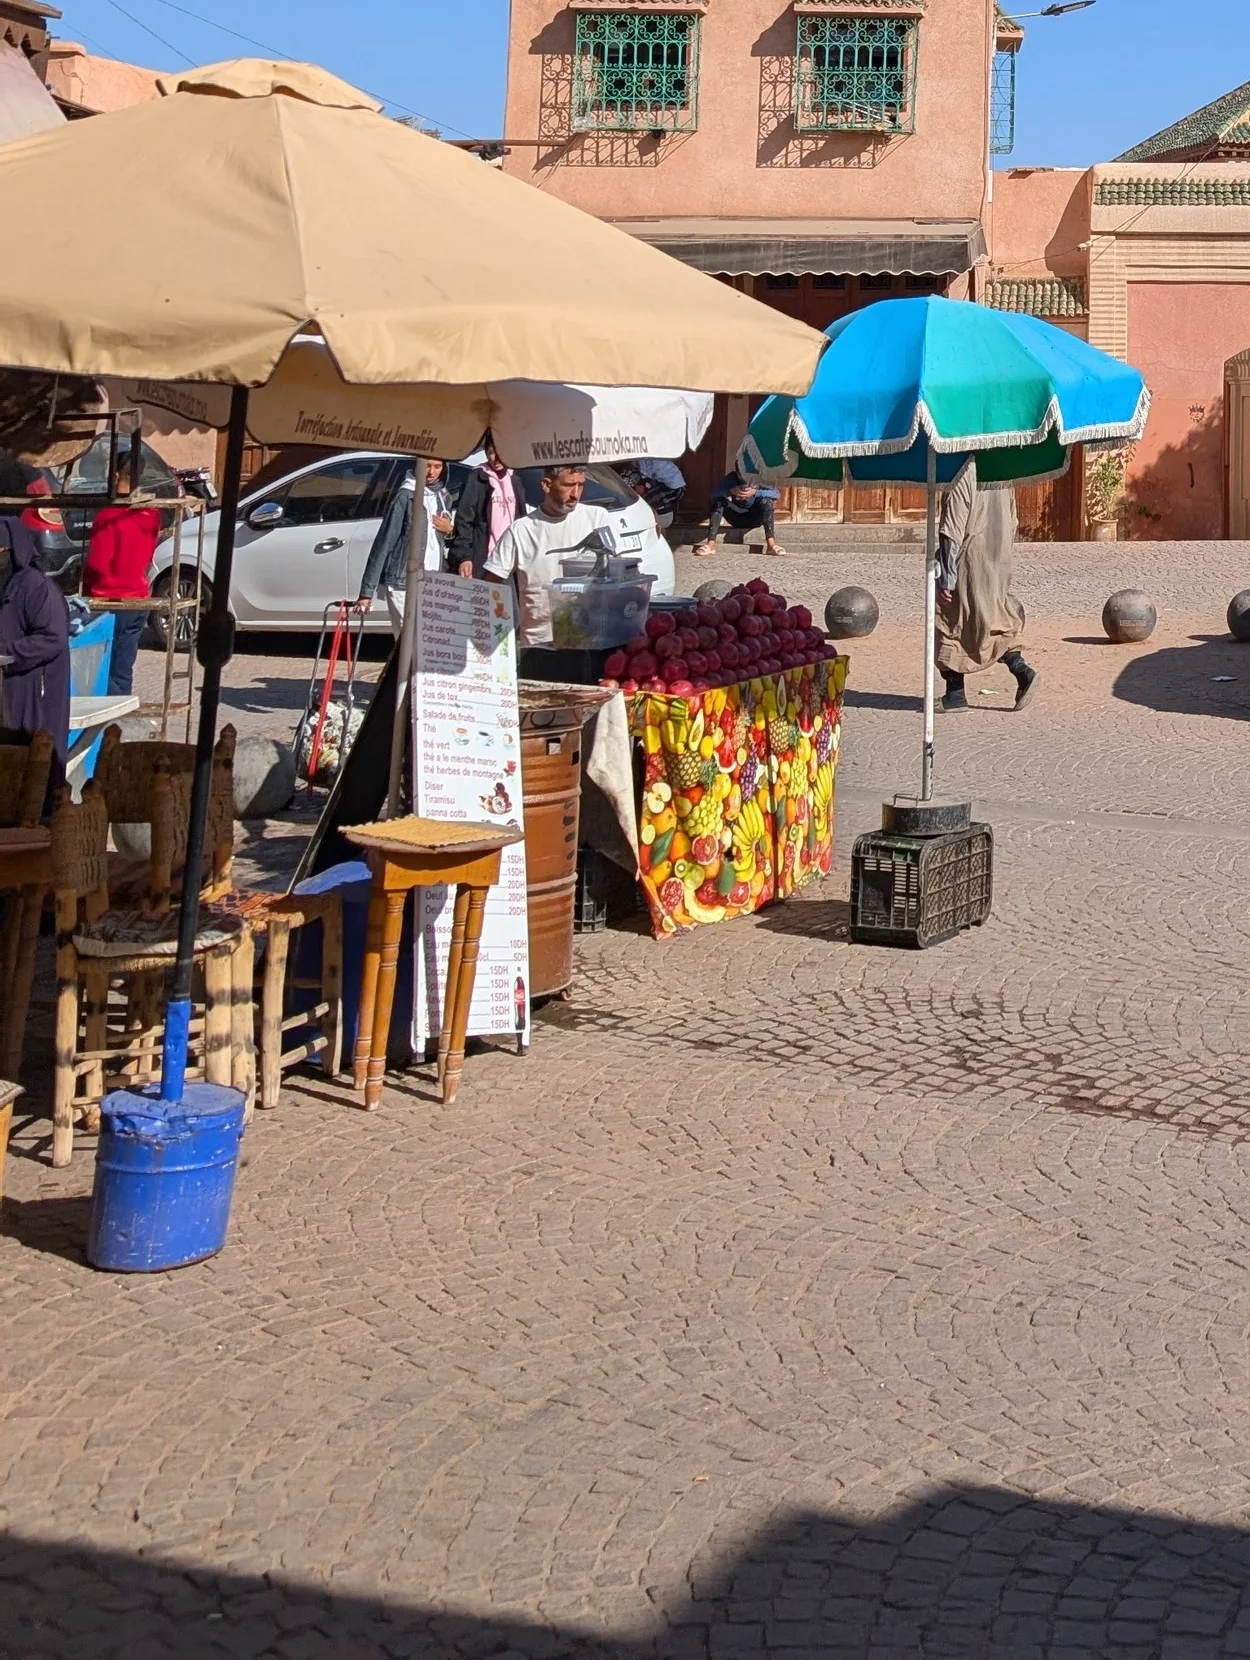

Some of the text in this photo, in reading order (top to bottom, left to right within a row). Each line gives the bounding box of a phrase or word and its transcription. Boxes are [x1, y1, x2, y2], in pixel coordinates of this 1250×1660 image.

[423, 678, 435, 687] Jus
[423, 709, 447, 719] Salade
[423, 723, 437, 734] Thé
[490, 966, 509, 975] 15DH
[490, 979, 510, 989] 15DH
[490, 993, 510, 1002] 15DH
[490, 1006, 510, 1015] 15DH
[490, 1019, 510, 1029] 15DH
